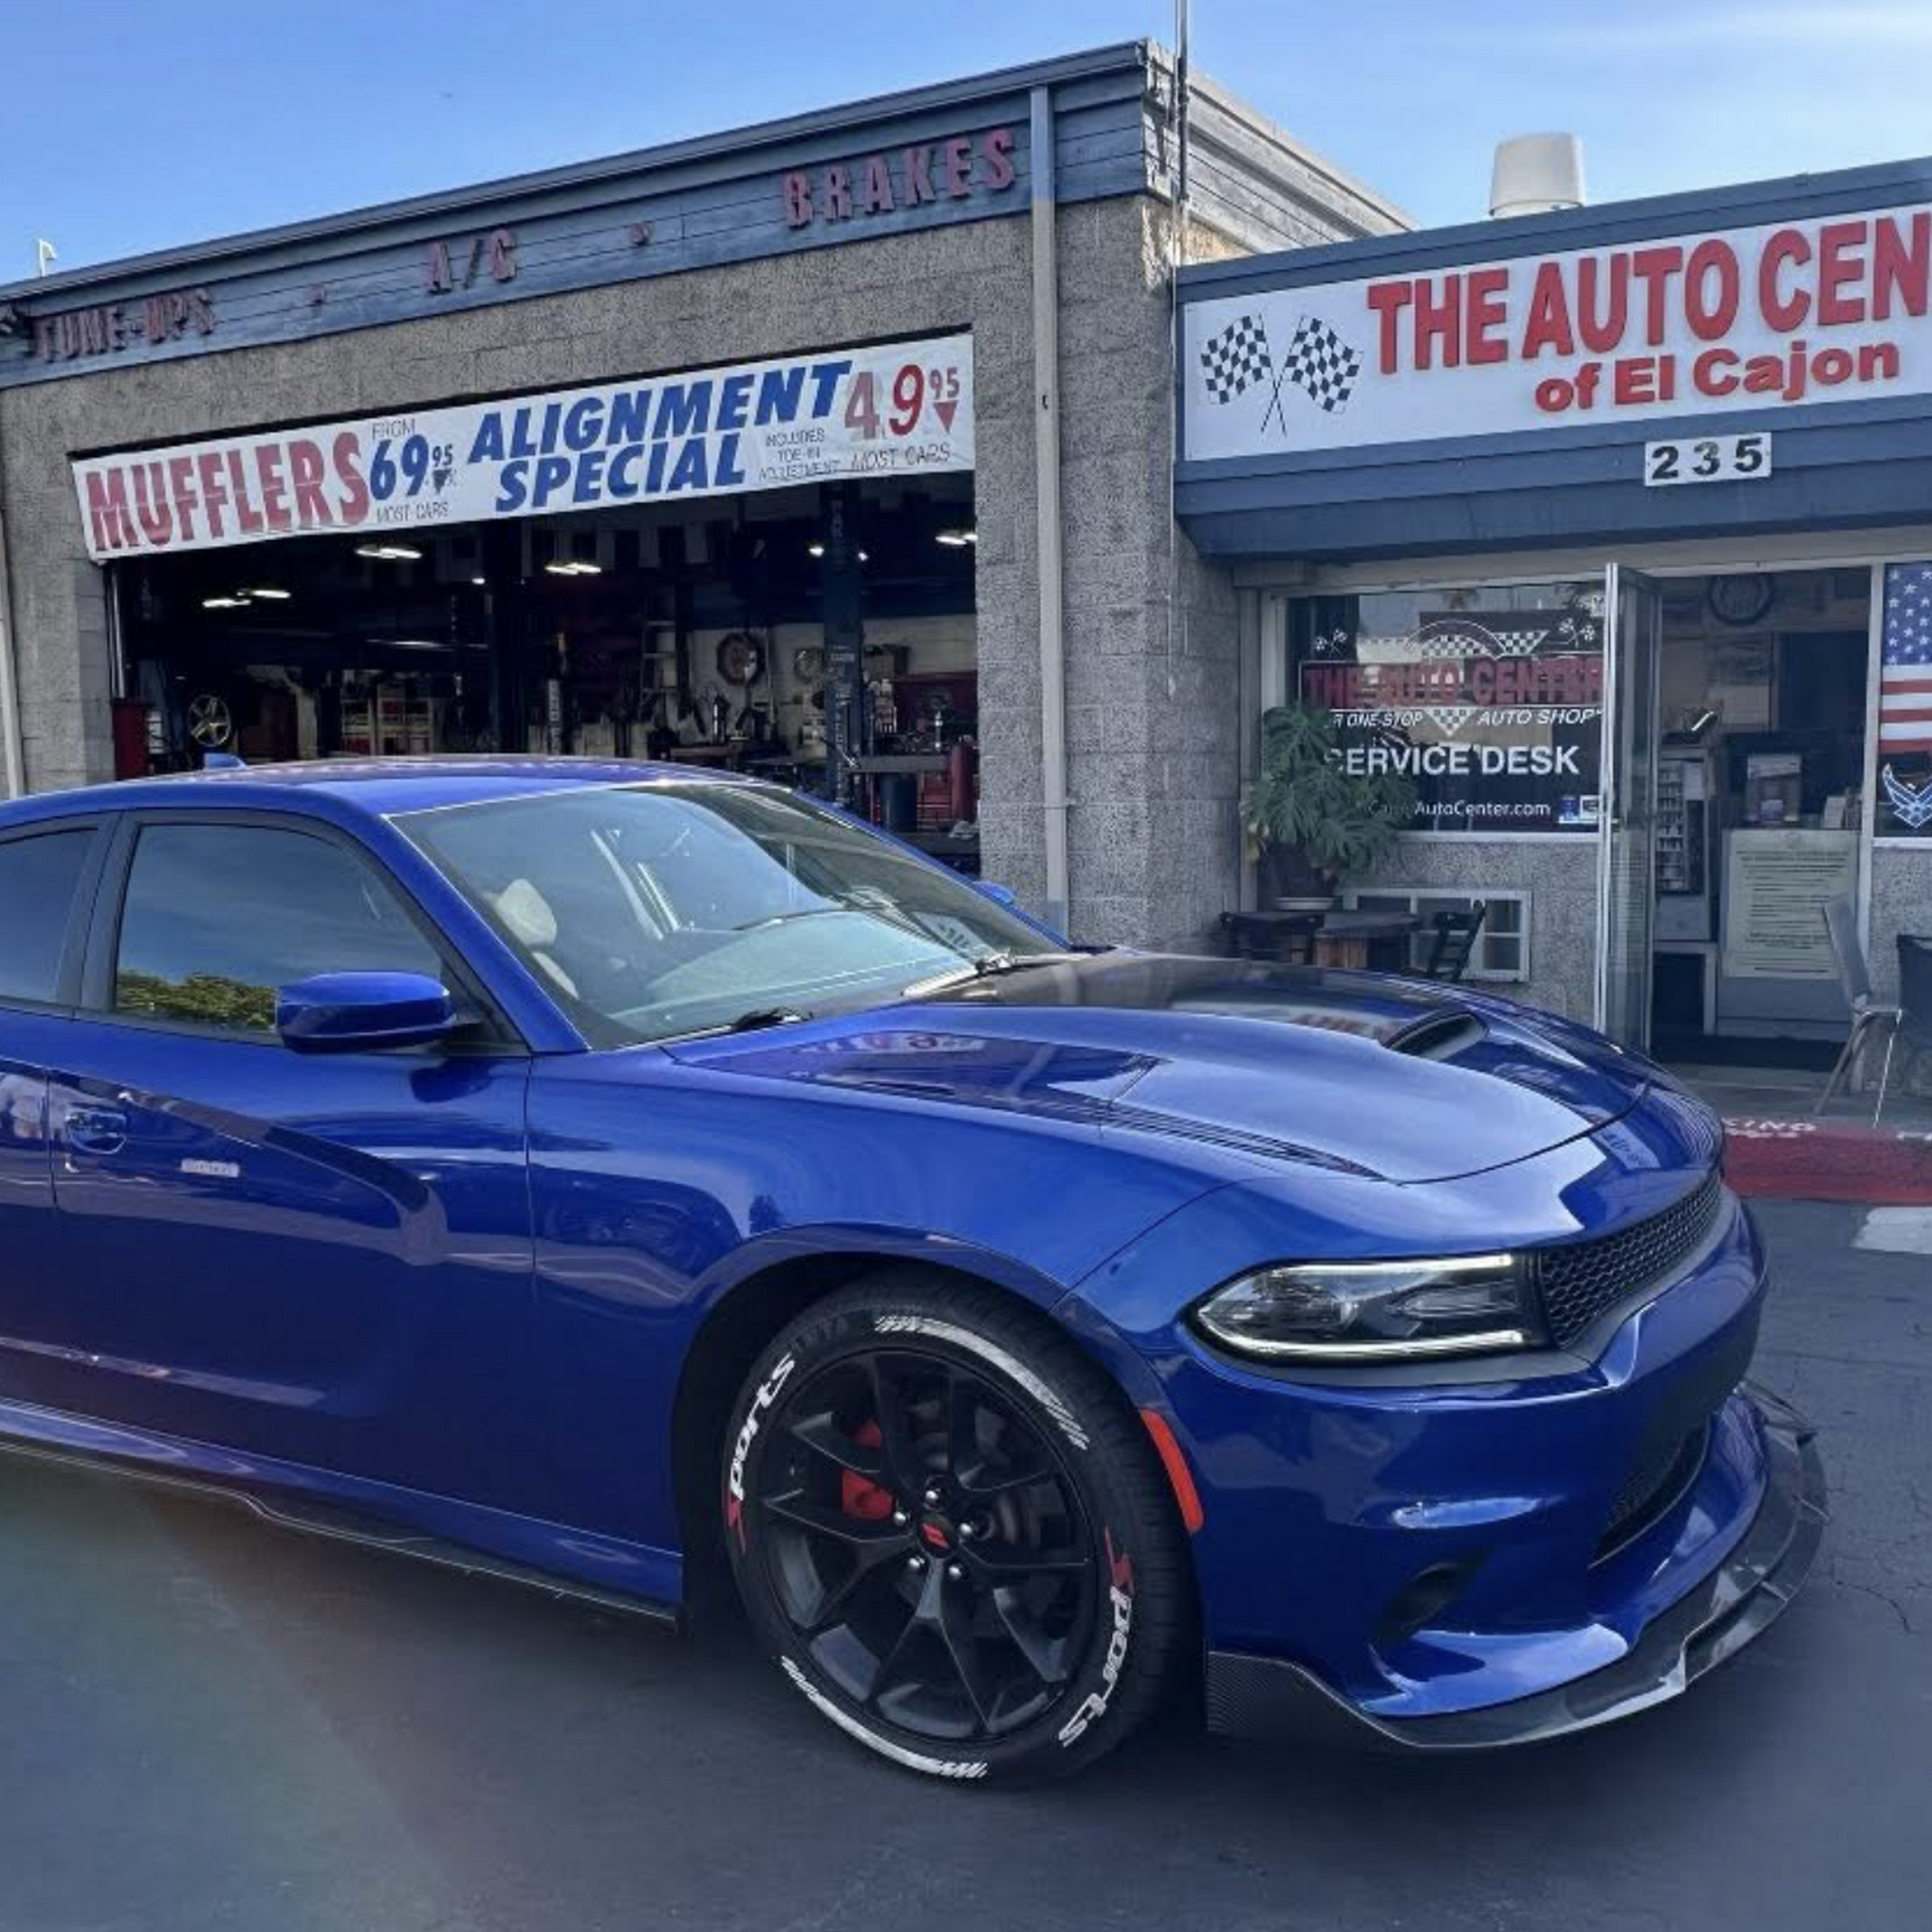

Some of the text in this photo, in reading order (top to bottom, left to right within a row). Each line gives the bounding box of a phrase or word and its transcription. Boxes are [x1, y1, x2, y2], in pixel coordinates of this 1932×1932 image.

[782, 128, 1015, 228] BRAKES
[426, 228, 517, 295] A/C
[1367, 212, 1932, 375] THE AUTO CEN
[929, 366, 960, 399] 95
[1535, 340, 1899, 412] of El Cajon
[372, 418, 415, 440] FROM
[469, 360, 853, 464] ALIGNMENT
[370, 435, 429, 500] 69
[432, 444, 453, 468] 95
[495, 432, 746, 512] SPECIAL
[852, 443, 952, 470] MOST CARS
[1651, 437, 1763, 480] 235
[85, 432, 370, 552] MUFFLERS
[377, 501, 449, 523] MOST CARS
[1477, 709, 1533, 725] AUTO
[1481, 746, 1579, 775] DESK
